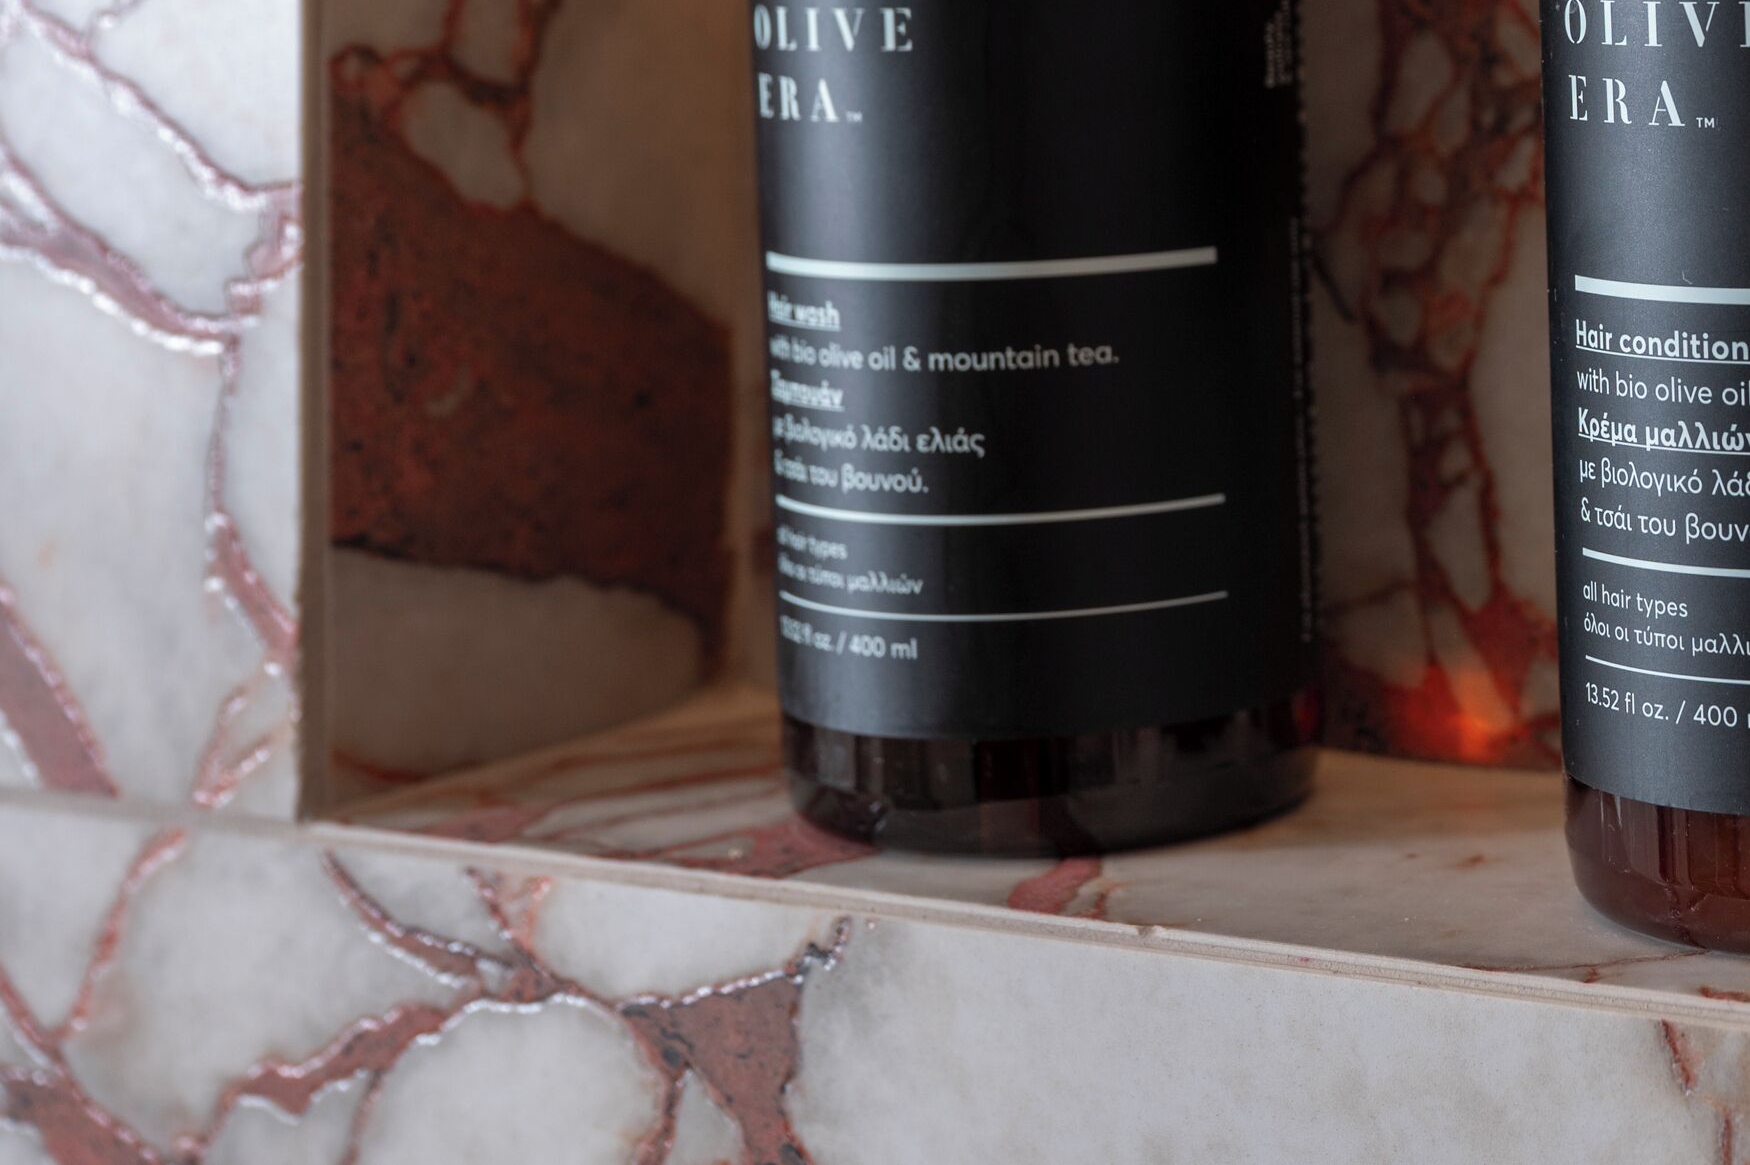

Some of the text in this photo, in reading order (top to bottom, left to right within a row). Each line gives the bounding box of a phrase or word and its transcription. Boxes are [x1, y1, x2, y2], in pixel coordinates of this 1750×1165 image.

[754, 4, 912, 53] OLIVE
[758, 73, 839, 122] ERA
[1569, 74, 1685, 128] ERA
[795, 300, 841, 326] wash
[1576, 319, 1612, 350] Hair
[818, 342, 864, 370] olive
[868, 345, 896, 370] oil
[903, 345, 921, 371] &
[928, 344, 1060, 372] mountain
[1066, 343, 1120, 367] tea.
[1577, 368, 1609, 395] with
[1615, 371, 1647, 399] bio
[1655, 376, 1712, 404] olive
[860, 424, 911, 453] λάδι
[916, 426, 985, 458] ελιάς
[1578, 406, 1637, 446] Κρέμα
[841, 462, 929, 495] βουνού.
[1580, 459, 1596, 483] με
[1601, 457, 1703, 497] βιολογικό
[1581, 497, 1591, 523] &
[1594, 504, 1632, 531] τσάι
[1637, 514, 1676, 536] του
[1583, 581, 1688, 619] all hair types
[836, 630, 847, 656] /
[849, 634, 886, 658] 400
[891, 637, 918, 660] ml
[1584, 612, 1610, 638] όλοι
[1615, 626, 1629, 642] οι
[1634, 626, 1685, 651] τύποι
[1586, 682, 1620, 711] 13.52
[1625, 692, 1635, 715] fl
[1642, 702, 1669, 721] oz.
[1675, 700, 1686, 724] /
[1693, 704, 1738, 727] 400
